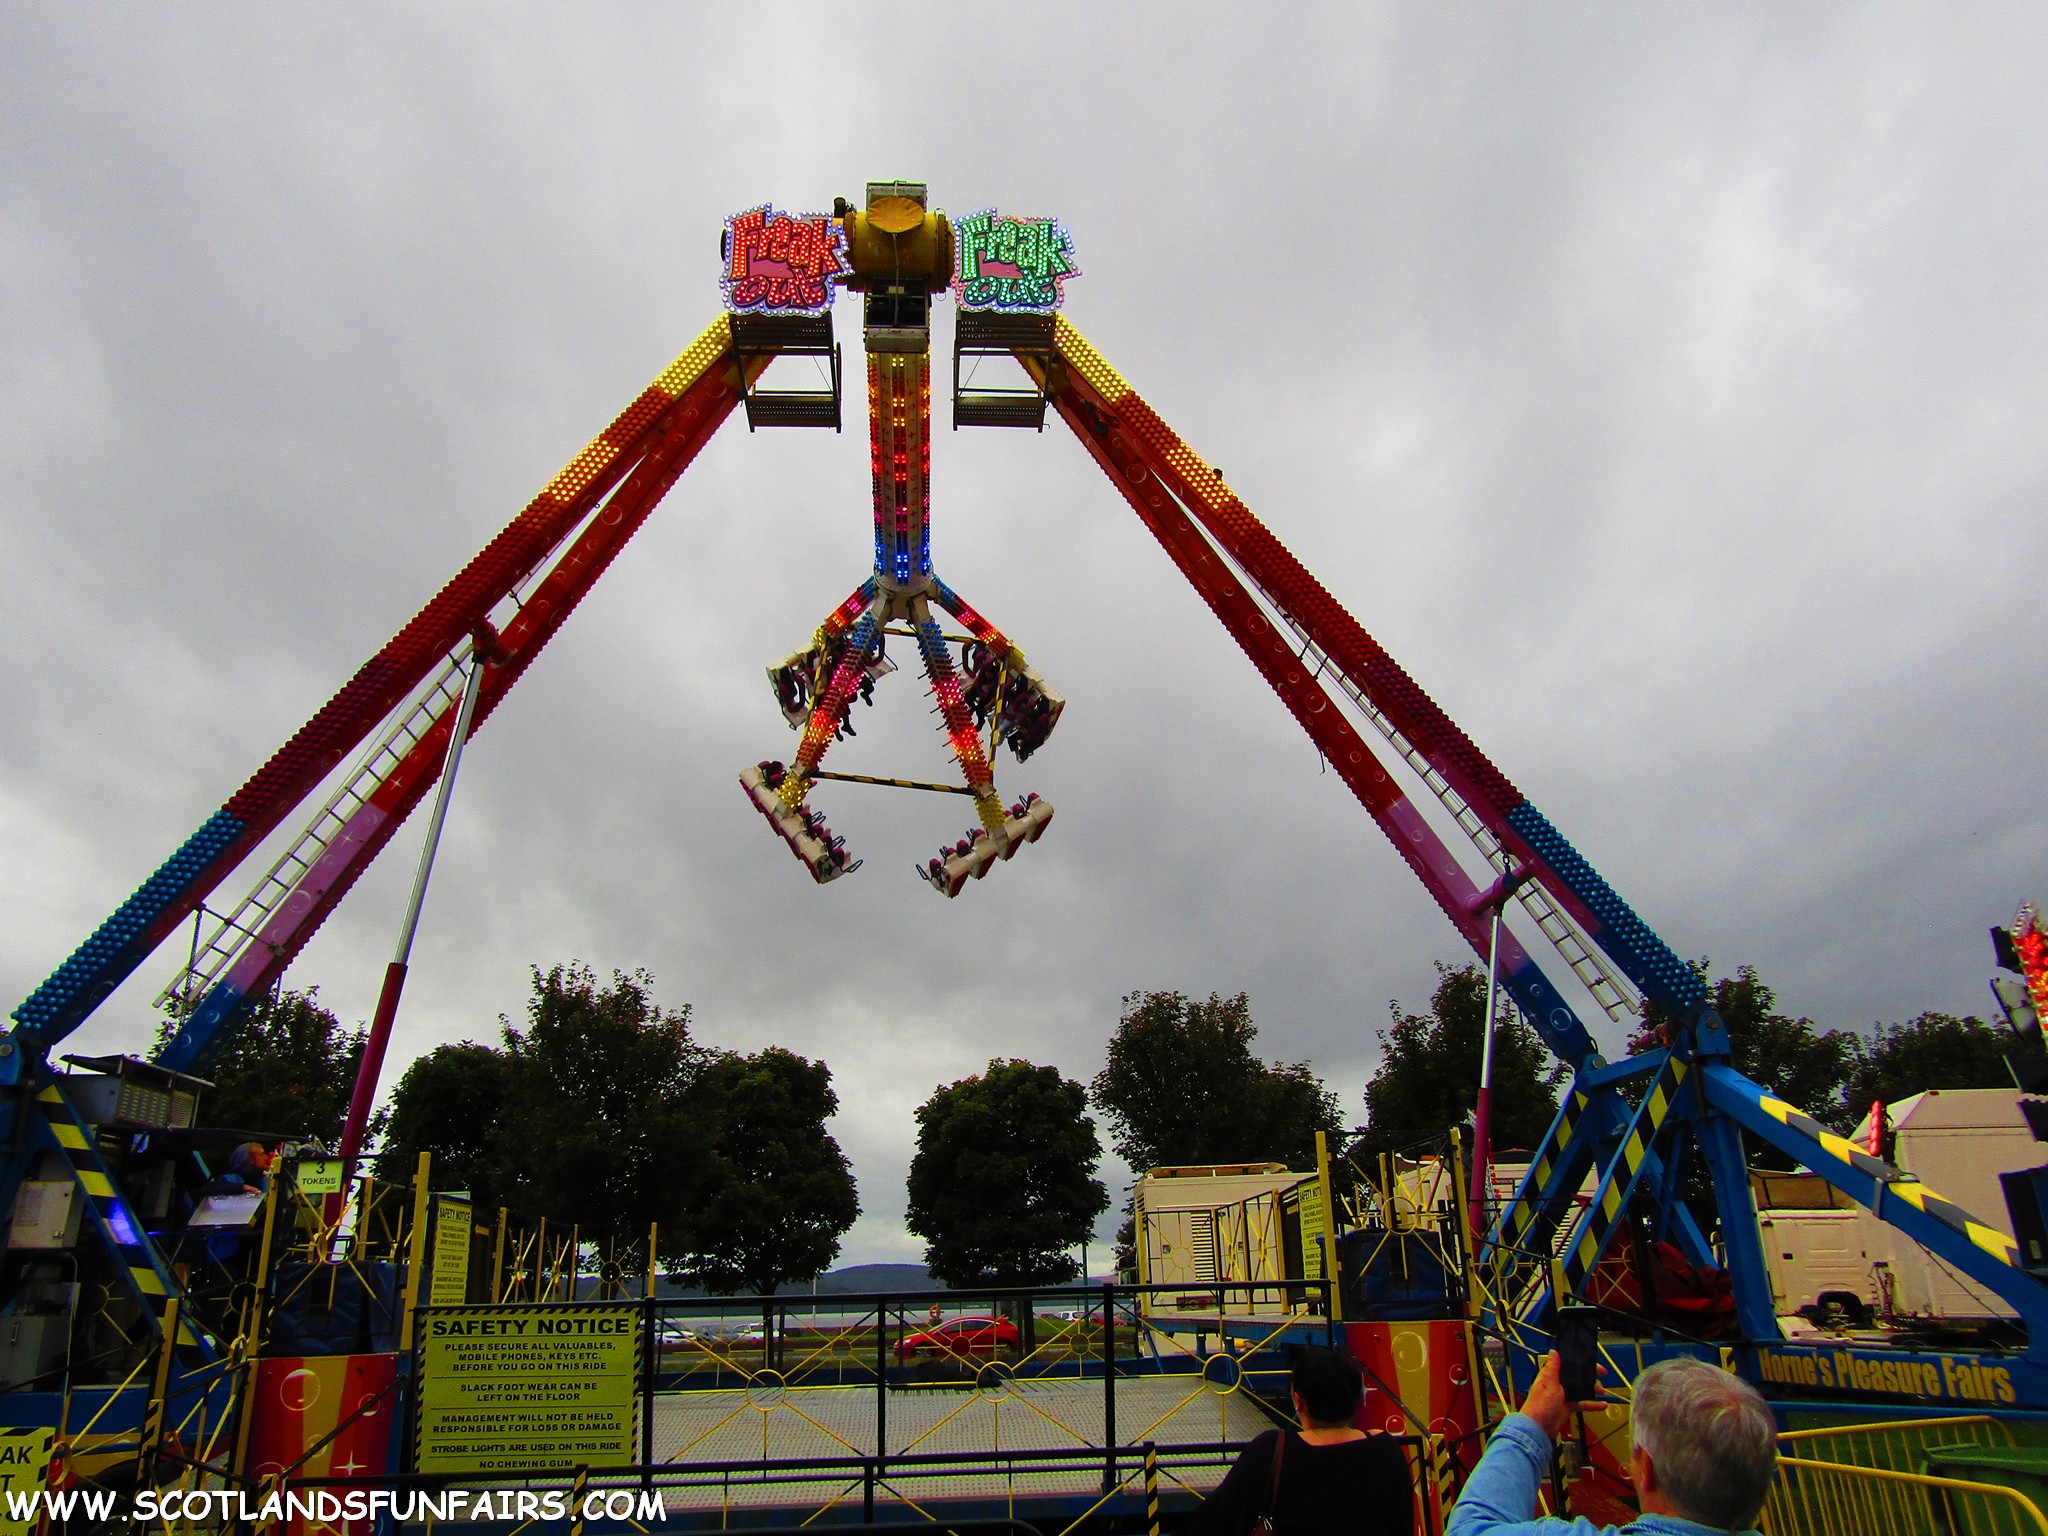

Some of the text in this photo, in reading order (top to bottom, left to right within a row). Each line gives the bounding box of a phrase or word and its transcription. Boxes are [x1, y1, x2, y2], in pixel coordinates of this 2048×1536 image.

[730, 211, 844, 281] Freak
[959, 215, 1072, 281] Freak
[315, 1161, 325, 1174] 3
[302, 1177, 336, 1185] TOKENS
[439, 1207, 471, 1222] SAFETY NOTICE
[432, 1318, 630, 1336] SAFETY NOTICE
[445, 1341, 615, 1351] PLEASE SECURE ALL VALUABLES,
[458, 1352, 601, 1362] MOBILE PHONES, KEYS ETC.
[452, 1362, 606, 1371] BEFORE YOU GO ON THIS RIDE
[1759, 1350, 2016, 1403] Horne's Pleasure Fairs
[461, 1382, 597, 1392] SLACK FOOT WEAR CAN BE
[477, 1392, 580, 1401] LEFT ON THE FLOOR
[441, 1412, 613, 1423] MANAGEMENT WILL NOT BE HELD
[433, 1422, 621, 1433] RESPONSIBLE FOR LOSS OR DAMAGE
[431, 1442, 621, 1453] STROBE LIGHTS ARE USED ON THIS RIDE
[0, 1445, 34, 1465] AK
[479, 1459, 573, 1468] NO CHEWING GUM
